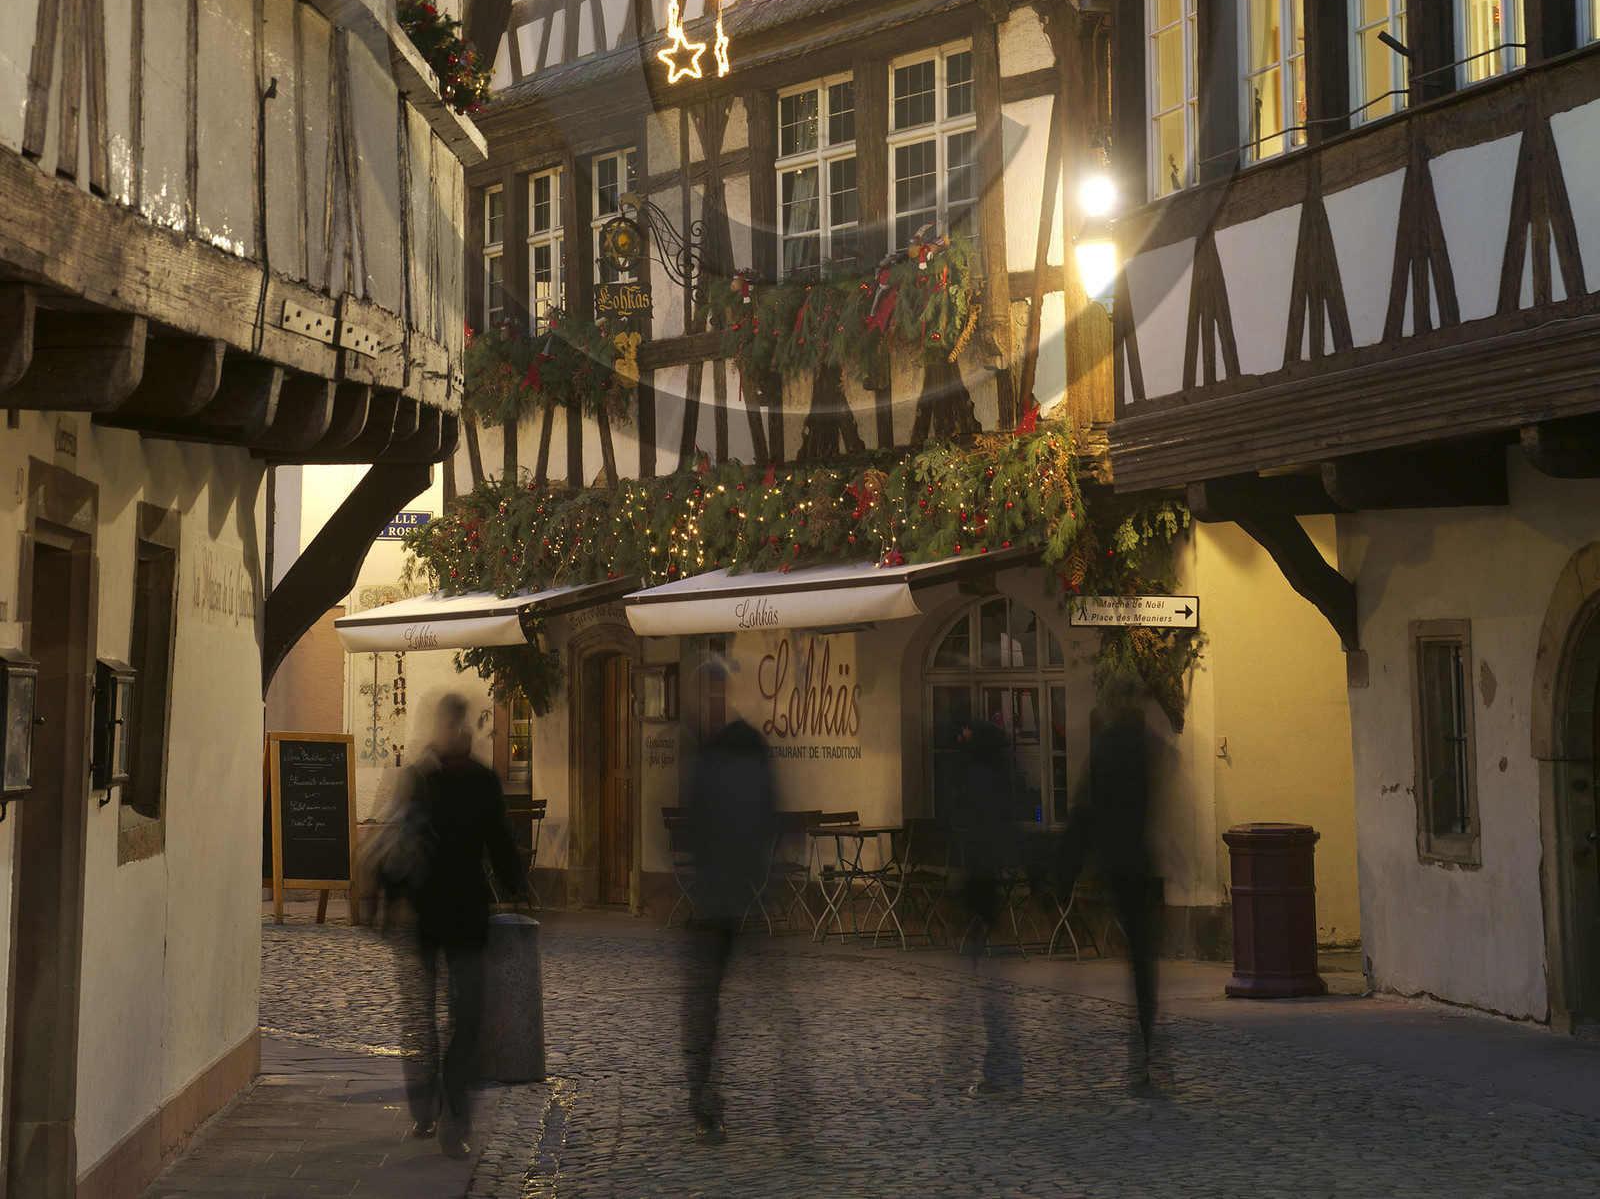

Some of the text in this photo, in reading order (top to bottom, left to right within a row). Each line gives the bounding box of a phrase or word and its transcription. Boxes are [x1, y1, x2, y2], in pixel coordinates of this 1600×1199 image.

[597, 285, 650, 316] Lohkäs
[735, 598, 779, 629] Lohkäs
[1133, 600, 1142, 609] de
[1146, 600, 1165, 609] Noël
[1091, 614, 1173, 623] Place des Meuniers
[404, 624, 439, 649] Lohkäs
[758, 637, 862, 739] Lohkäs
[809, 746, 820, 759] DE
[822, 746, 862, 759] TRADITION
